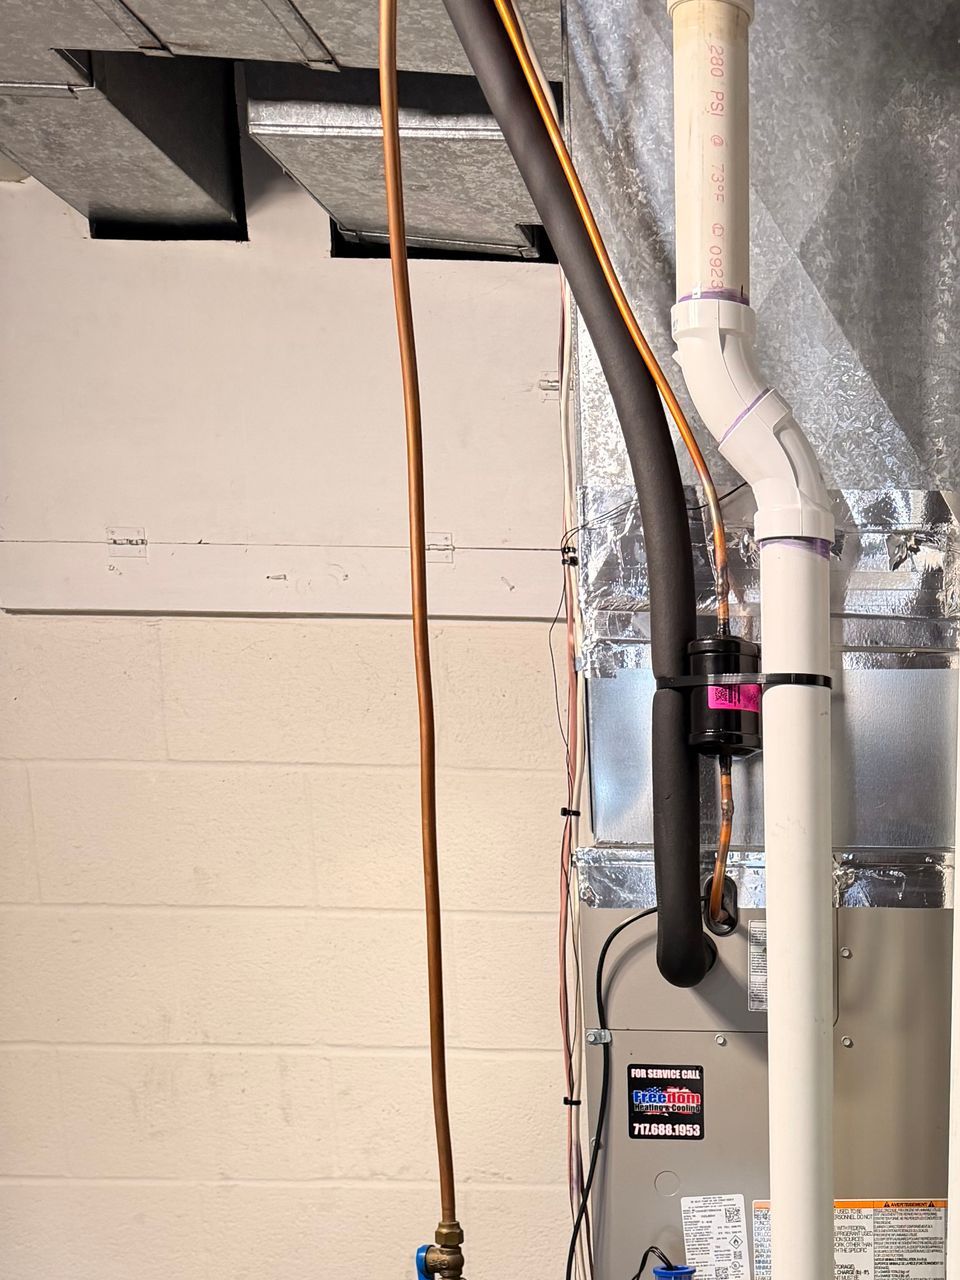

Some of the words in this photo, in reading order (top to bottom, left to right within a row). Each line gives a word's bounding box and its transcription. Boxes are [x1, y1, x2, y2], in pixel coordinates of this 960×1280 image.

[710, 45, 725, 78] 280
[710, 90, 725, 117] PSI
[710, 134, 724, 147] @
[709, 245, 725, 290] 0923
[631, 1068, 647, 1078] FOR
[647, 1069, 681, 1079] SERVICE
[681, 1069, 701, 1080] CALL
[633, 1090, 701, 1105] Freedom
[633, 1103, 664, 1112] Heating
[671, 1104, 701, 1113] Cooling
[633, 1123, 701, 1137] 717.688.1953
